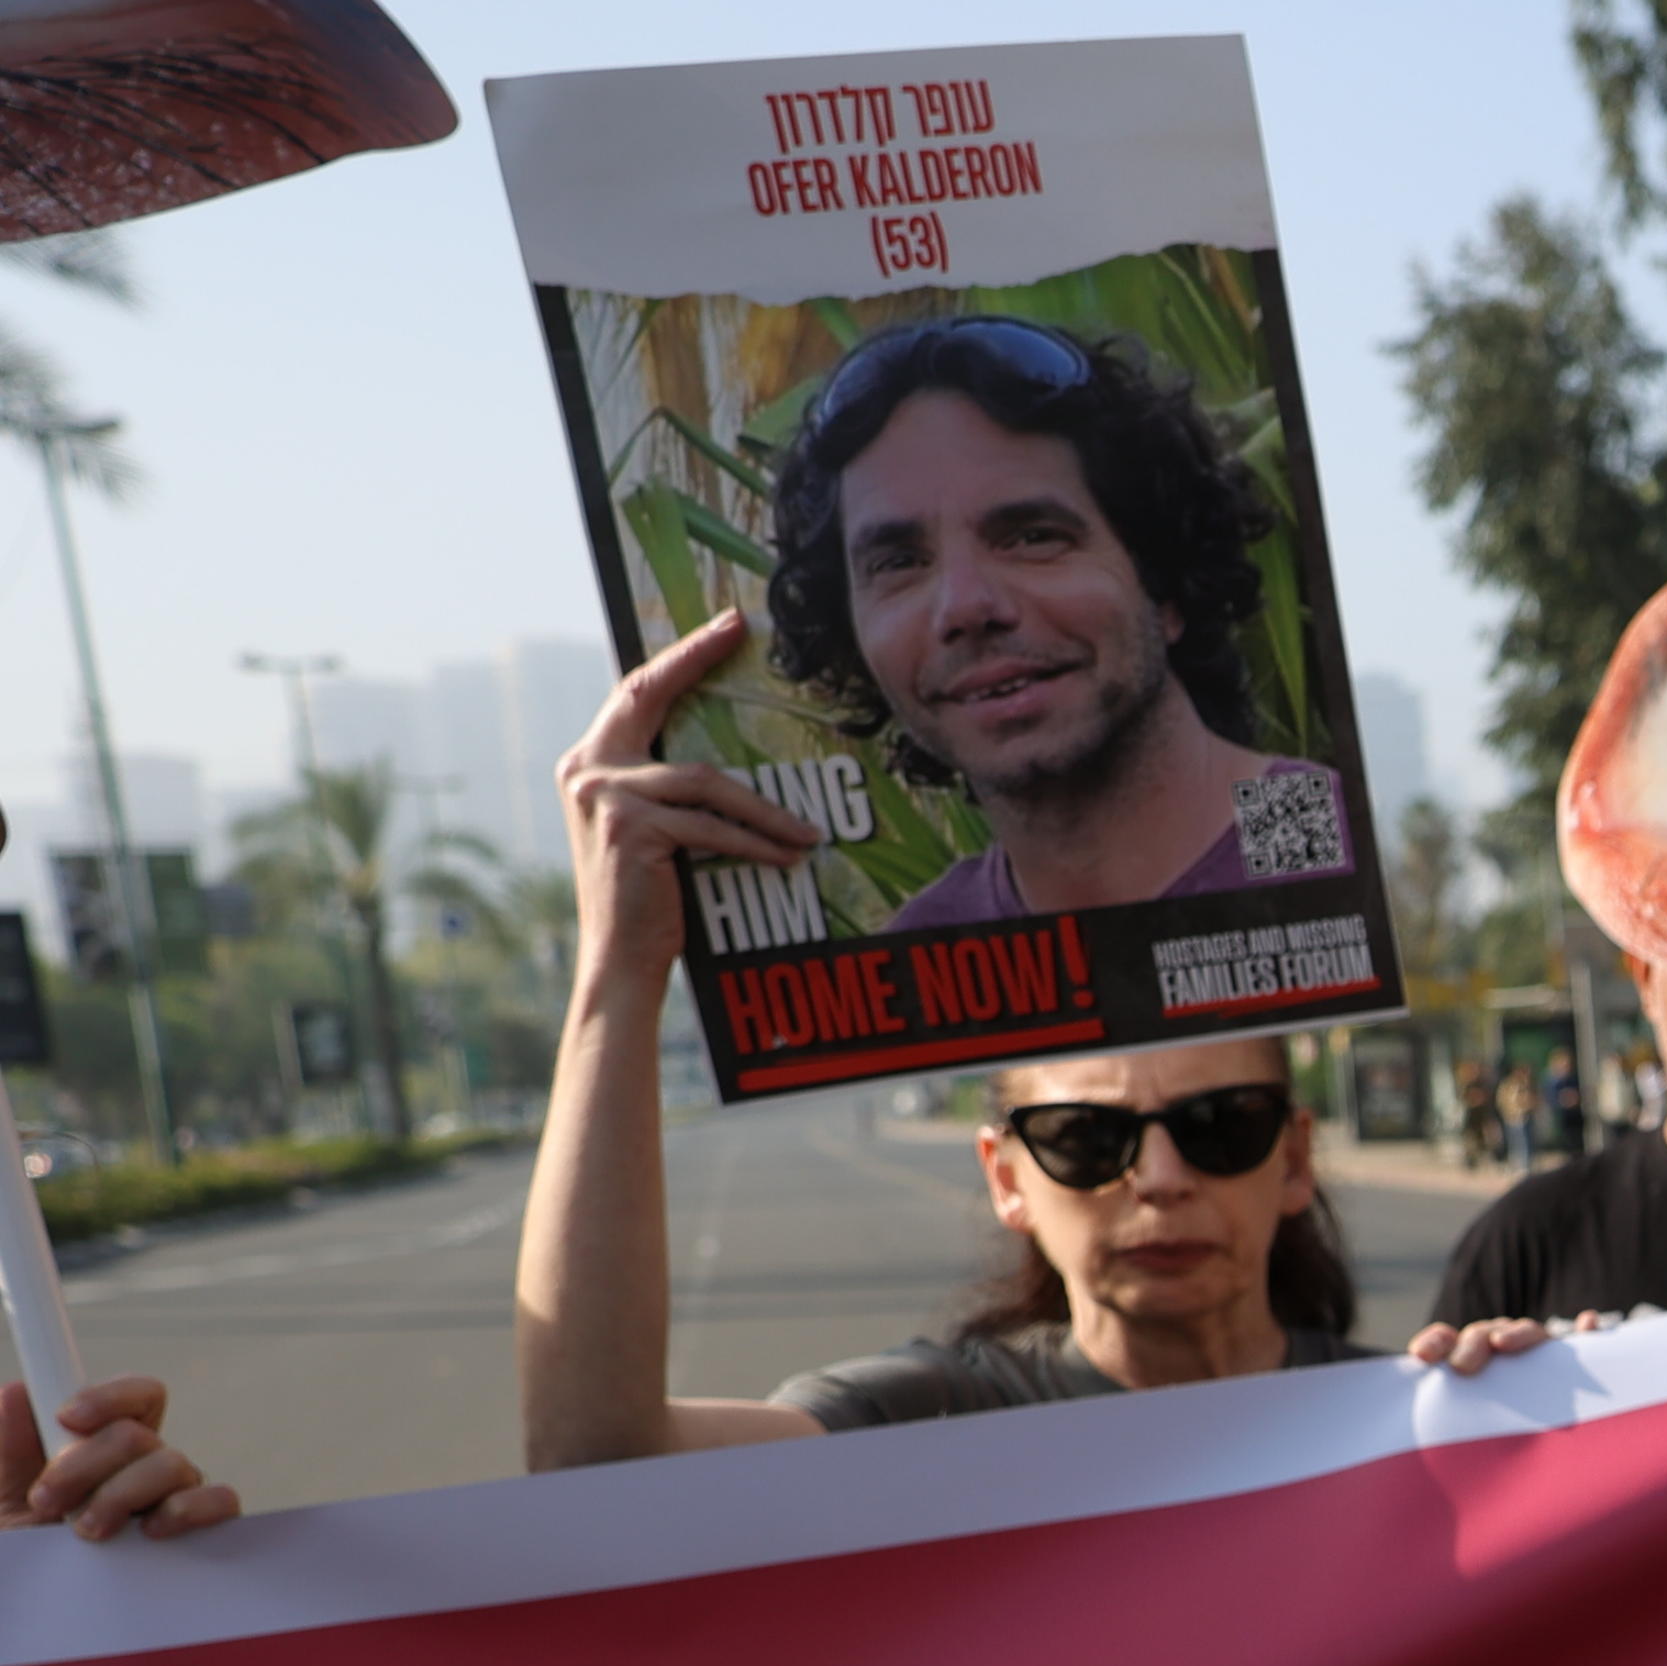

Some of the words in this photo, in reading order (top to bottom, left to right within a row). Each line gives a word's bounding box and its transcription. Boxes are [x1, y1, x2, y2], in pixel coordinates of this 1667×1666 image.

[764, 84, 896, 155] קלדרון
[902, 79, 994, 137] עופר
[748, 157, 845, 217] OFER
[848, 141, 1043, 209] KALDERON
[871, 210, 949, 279] (53)
[695, 857, 827, 956] HIM
[1152, 929, 1247, 969] HOSTAGES
[1247, 925, 1286, 956] AND
[1286, 913, 1367, 951] MISSING
[720, 949, 905, 1056] HOME
[910, 915, 1094, 1027] NOW!
[1159, 955, 1278, 1009] FAMILIES
[1280, 943, 1374, 992] FORUM
